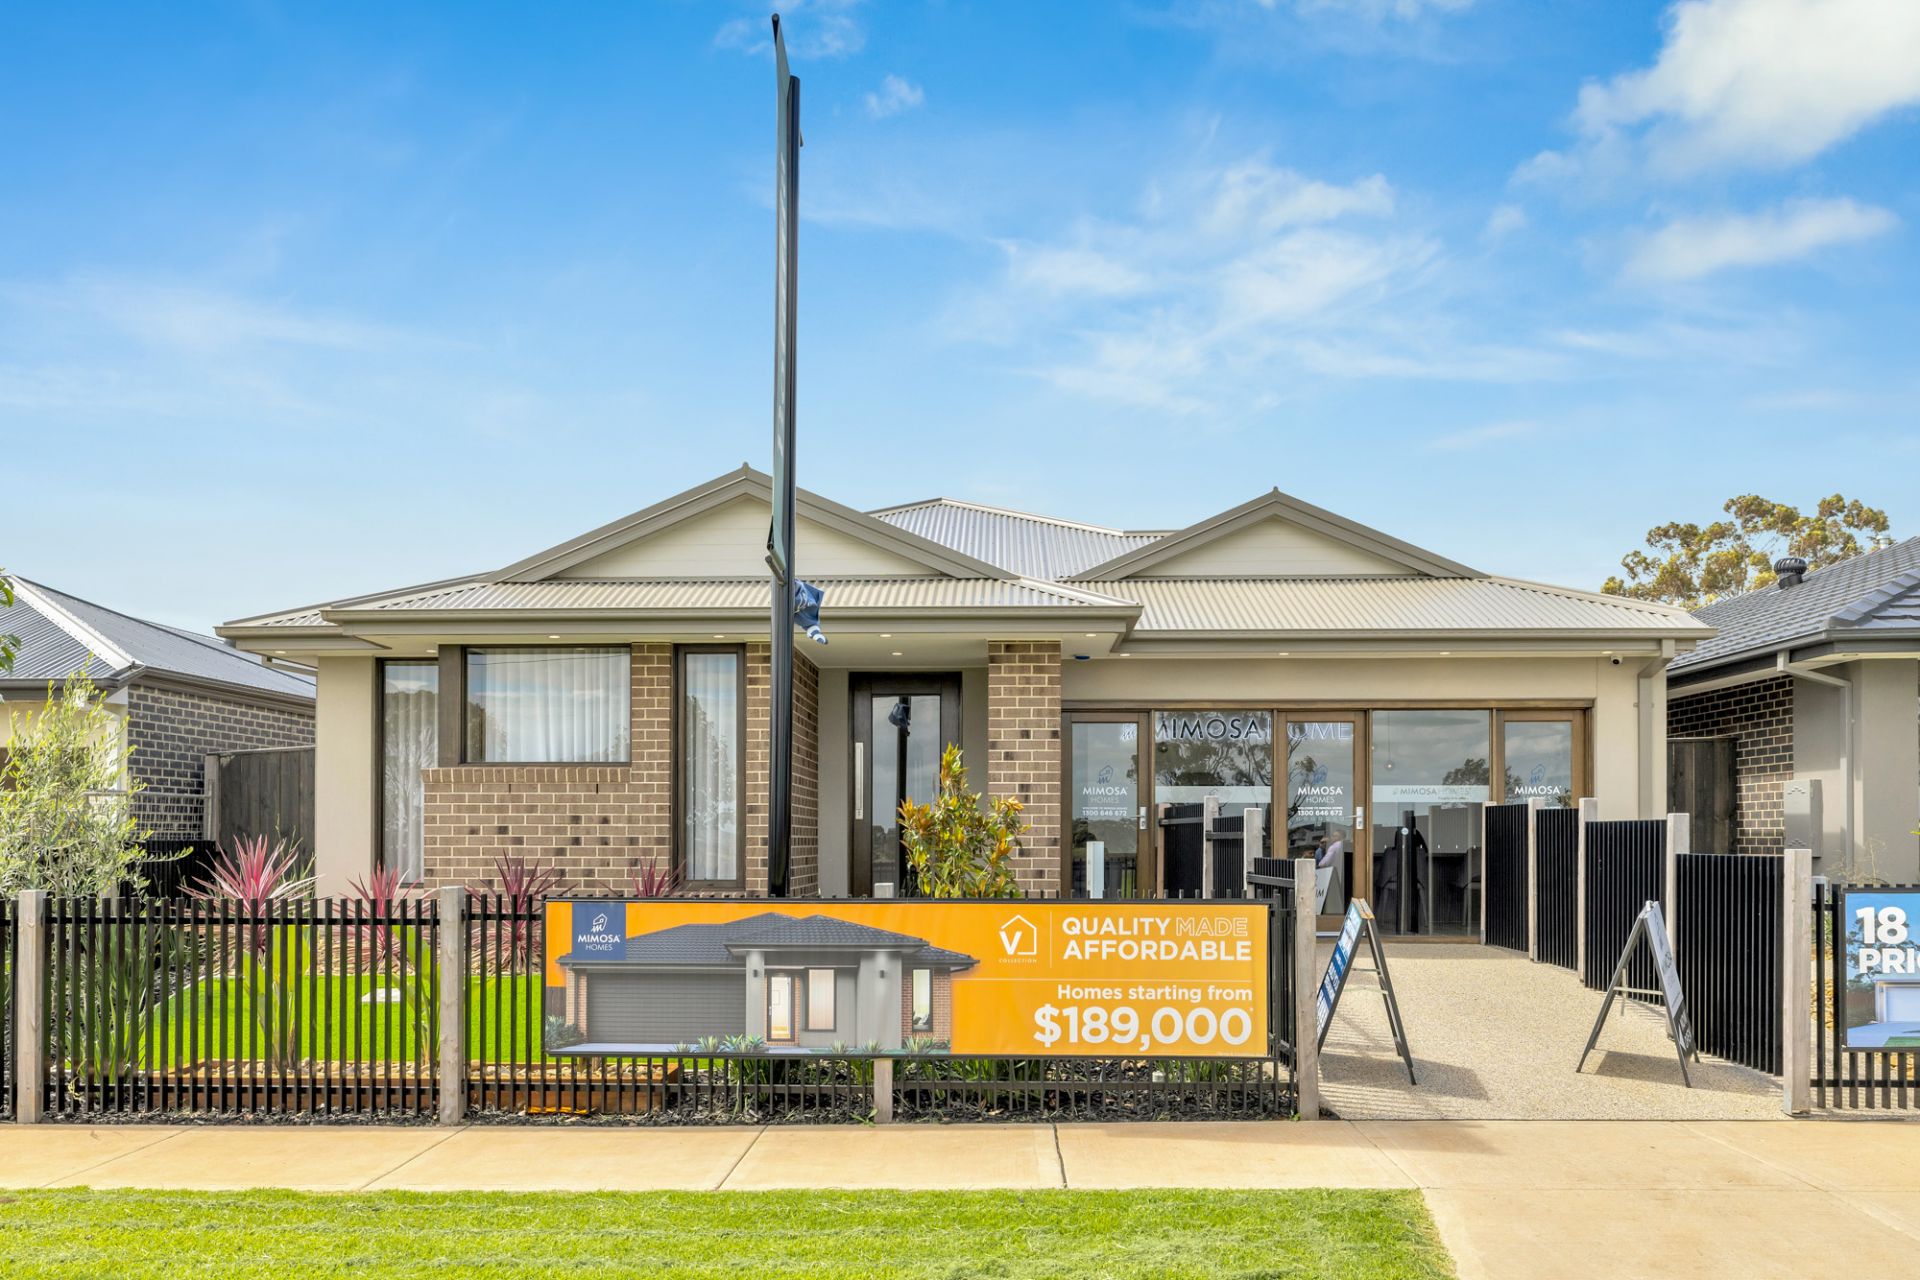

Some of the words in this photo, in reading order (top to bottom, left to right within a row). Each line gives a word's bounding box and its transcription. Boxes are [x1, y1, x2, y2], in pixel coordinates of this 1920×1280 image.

[1083, 786, 1128, 796] MIMOSA
[1297, 786, 1343, 796] MIMOSA
[1400, 787, 1437, 796] MIMOSA
[1514, 785, 1561, 795] MIMOSA
[1062, 917, 1171, 936] QUALITY
[1175, 917, 1248, 937] MADE
[1855, 906, 1908, 945] 18
[577, 934, 621, 943] MIMOSA
[585, 943, 613, 951] HOMES
[1063, 940, 1252, 961] AFFORDABLE
[1859, 948, 1920, 974] PRI
[1057, 984, 1123, 1000] Homes
[1128, 984, 1202, 1003] starting
[1207, 985, 1253, 1001] from
